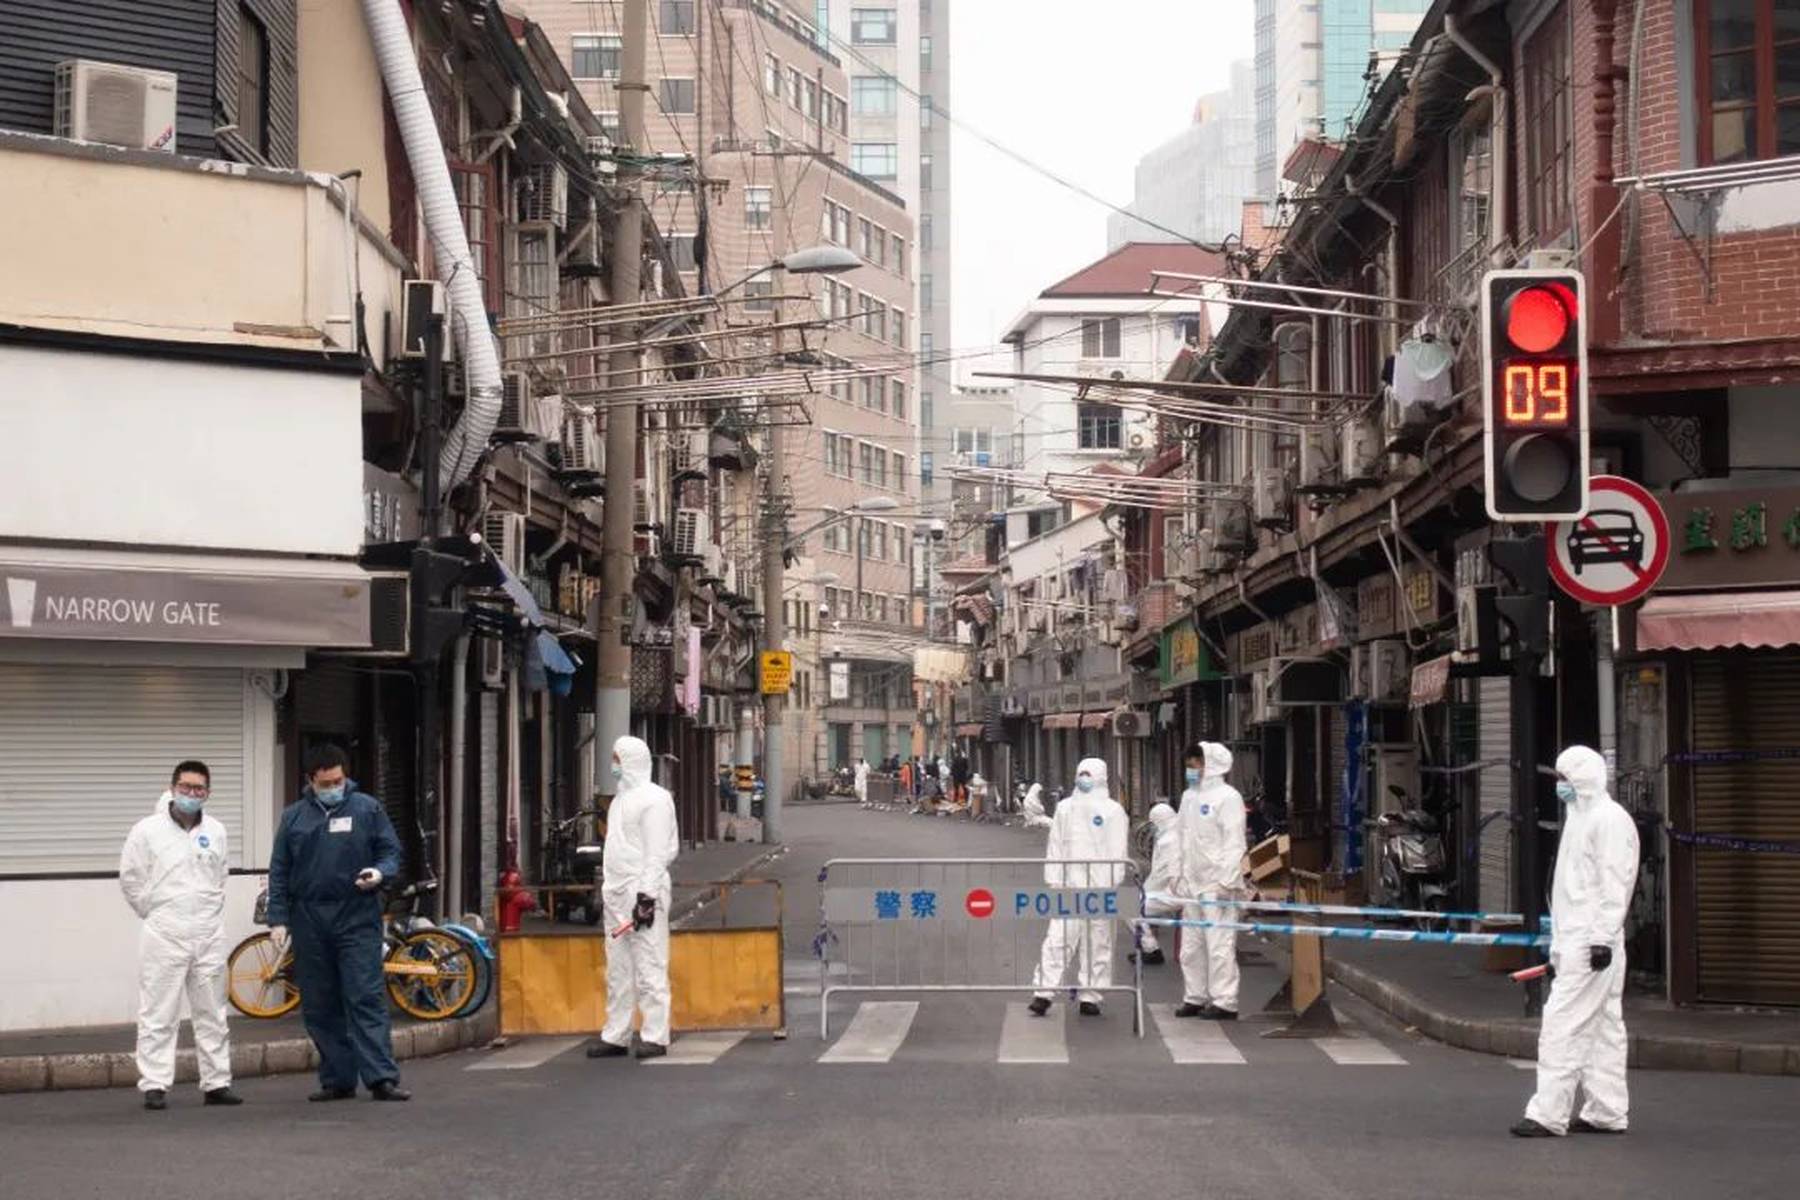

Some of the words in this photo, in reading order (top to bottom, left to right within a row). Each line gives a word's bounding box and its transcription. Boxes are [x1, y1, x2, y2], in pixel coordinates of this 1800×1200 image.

[1506, 366, 1568, 420] 09
[45, 596, 155, 623] NARROW
[162, 602, 222, 626] GATE
[875, 890, 937, 919] 警察
[1015, 891, 1119, 916] POLICE
